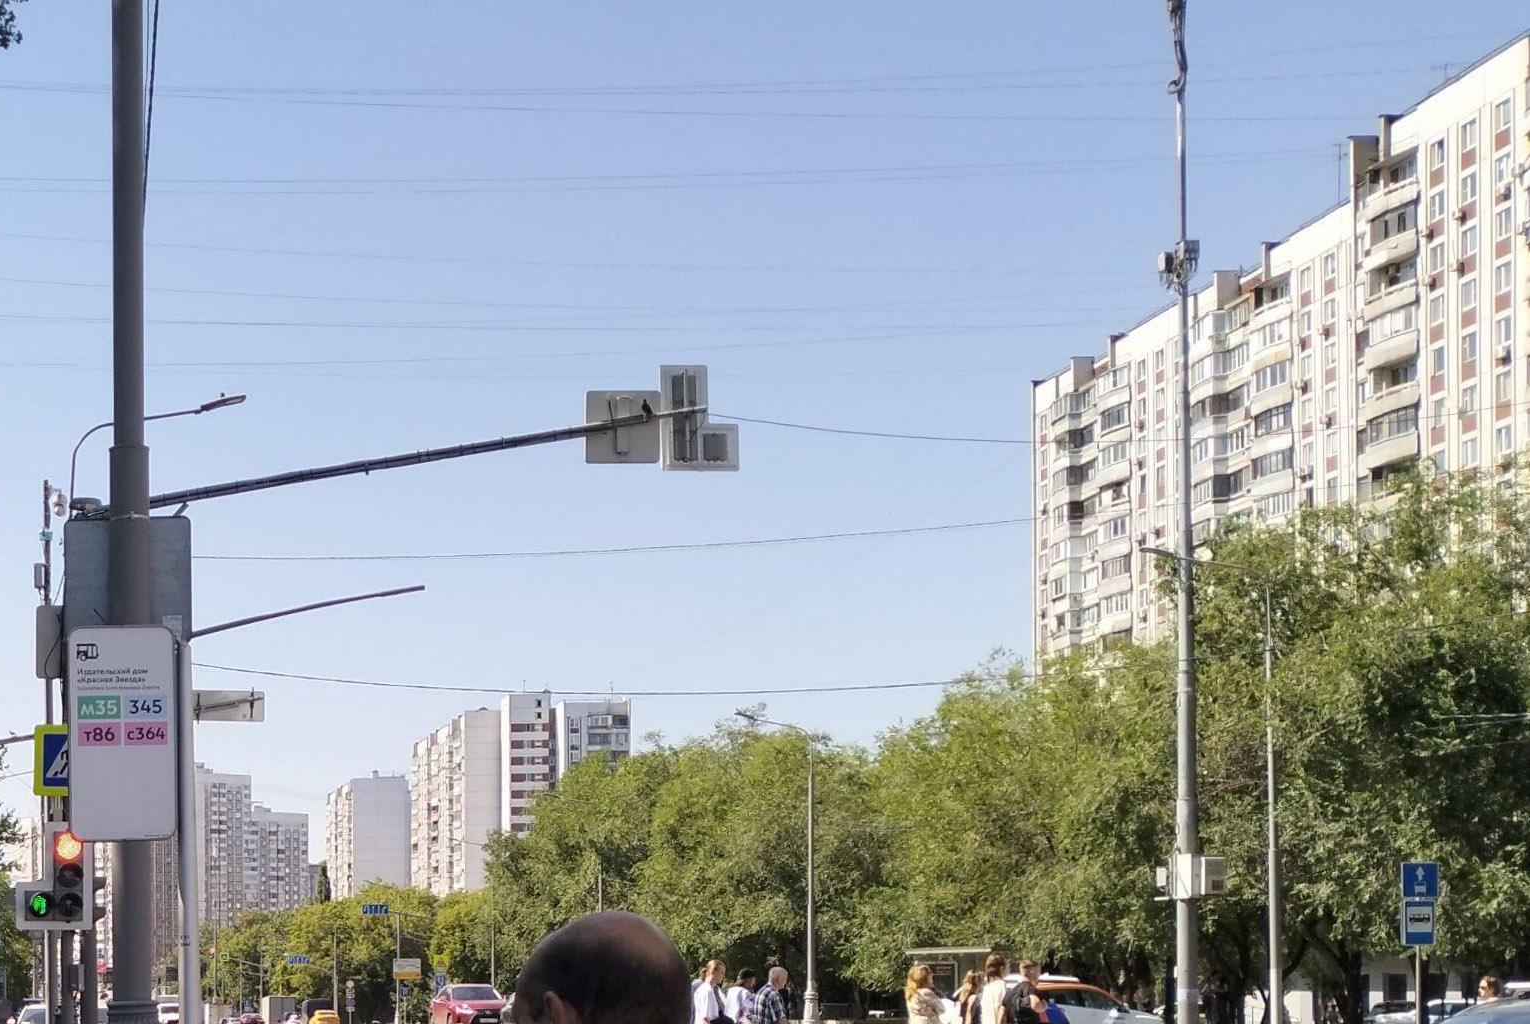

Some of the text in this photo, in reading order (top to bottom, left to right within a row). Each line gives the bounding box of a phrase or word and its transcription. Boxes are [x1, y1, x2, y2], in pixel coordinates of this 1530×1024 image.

[80, 699, 162, 716] м35 345
[84, 727, 165, 742] т86 с364
